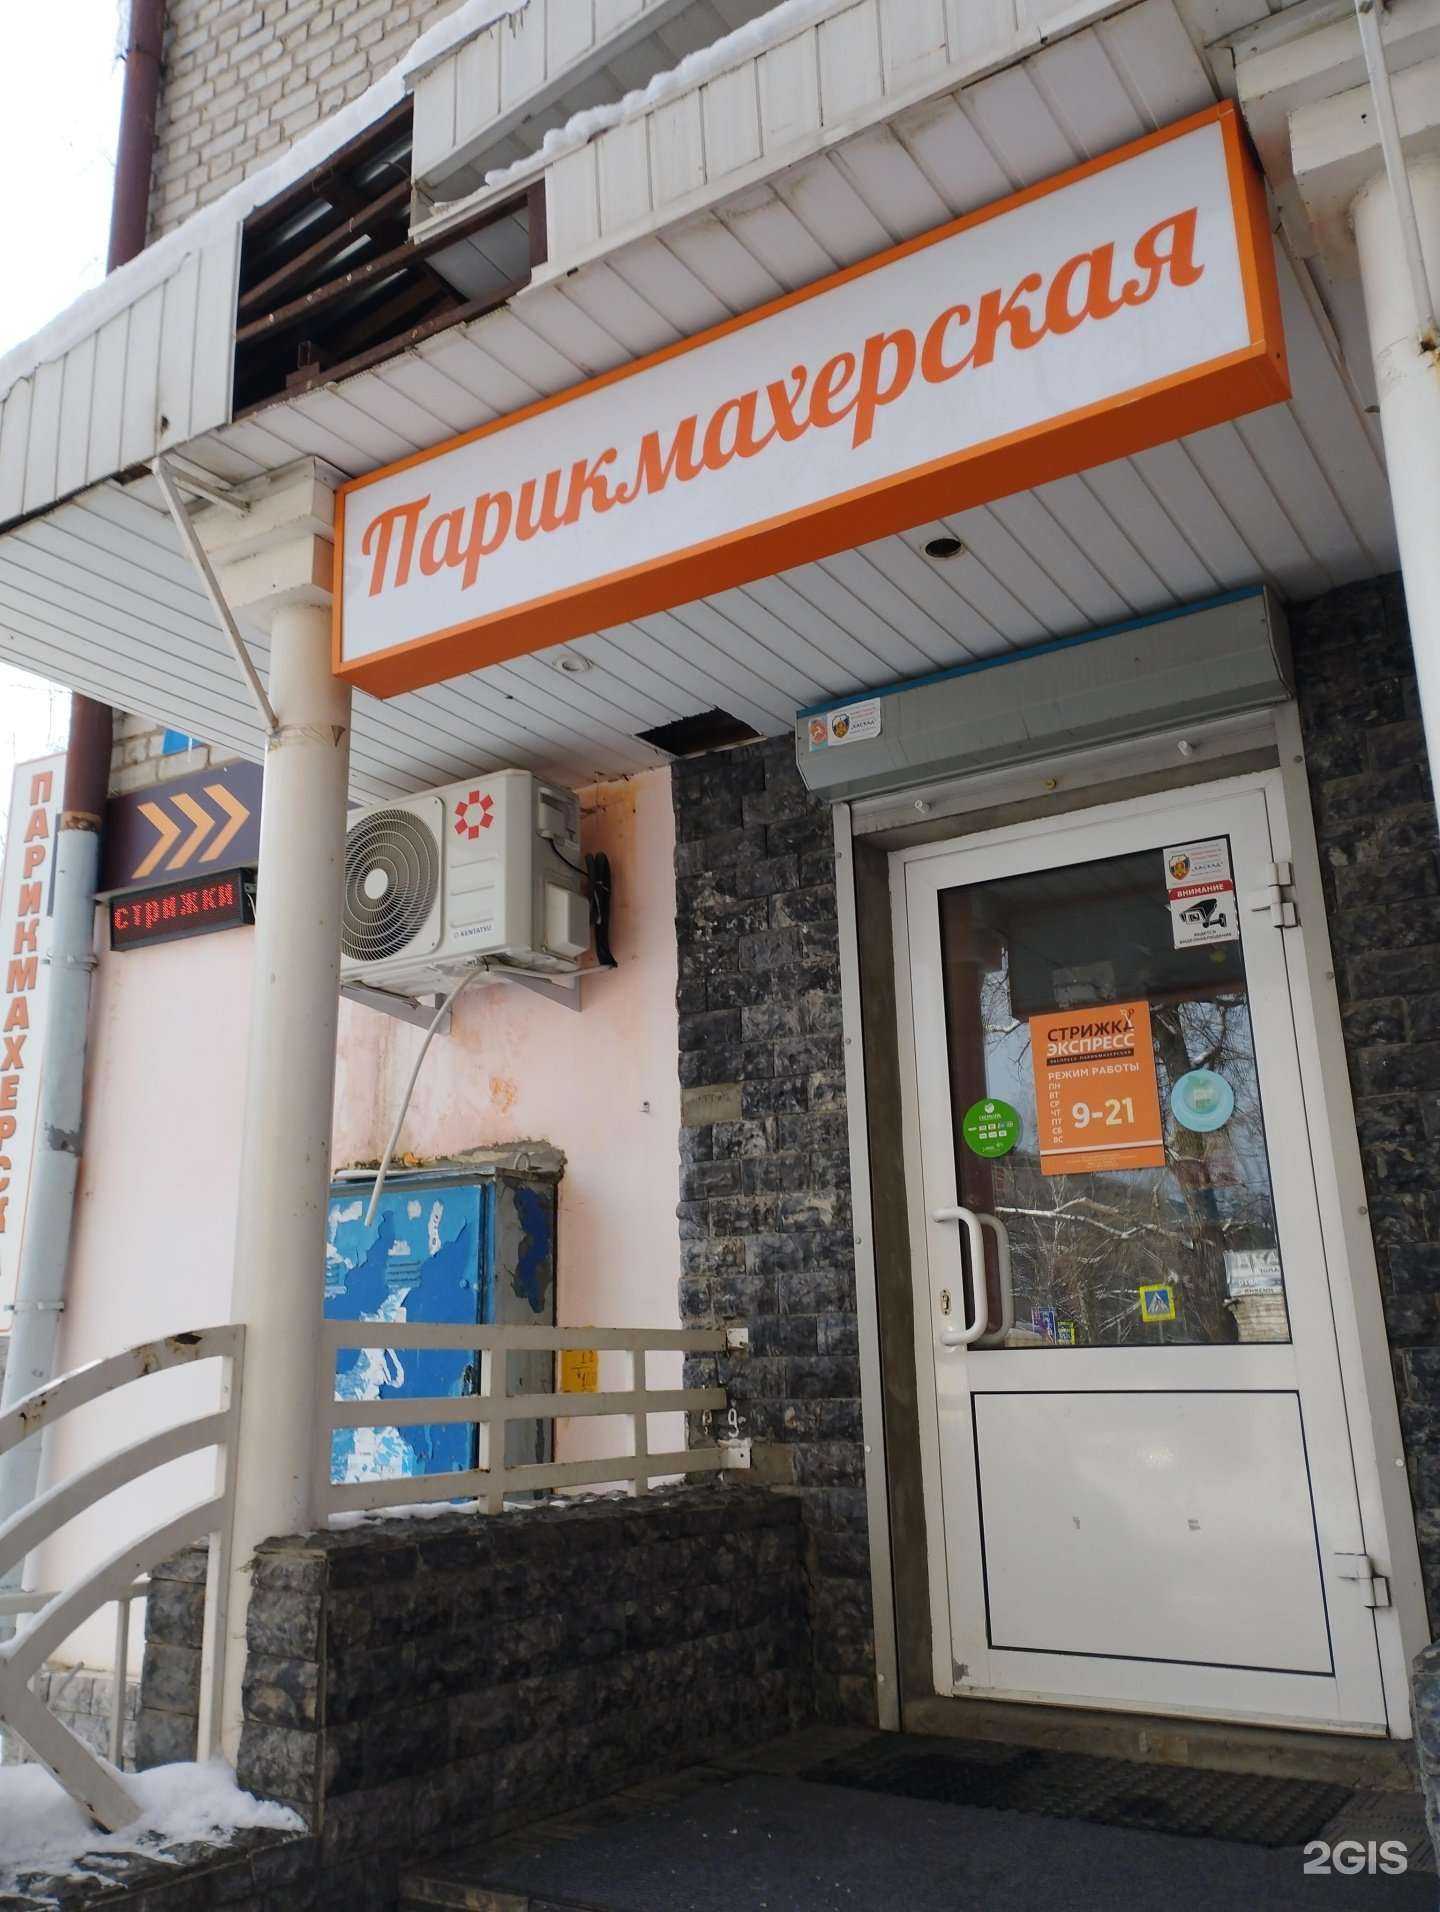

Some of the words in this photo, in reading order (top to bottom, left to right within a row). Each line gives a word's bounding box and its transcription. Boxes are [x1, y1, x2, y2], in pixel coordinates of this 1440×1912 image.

[361, 207, 1206, 598] Парикмахерская
[1177, 884, 1224, 897] ВНИМАНИЕ
[1047, 1014, 1135, 1042] СТРИЖКА
[1047, 1033, 1135, 1057] ЭКСПРЕСС
[1048, 1068, 1089, 1081] РЕЖИМ
[1092, 1062, 1140, 1076] РАБОТЫ
[1071, 1097, 1135, 1128] 9-21
